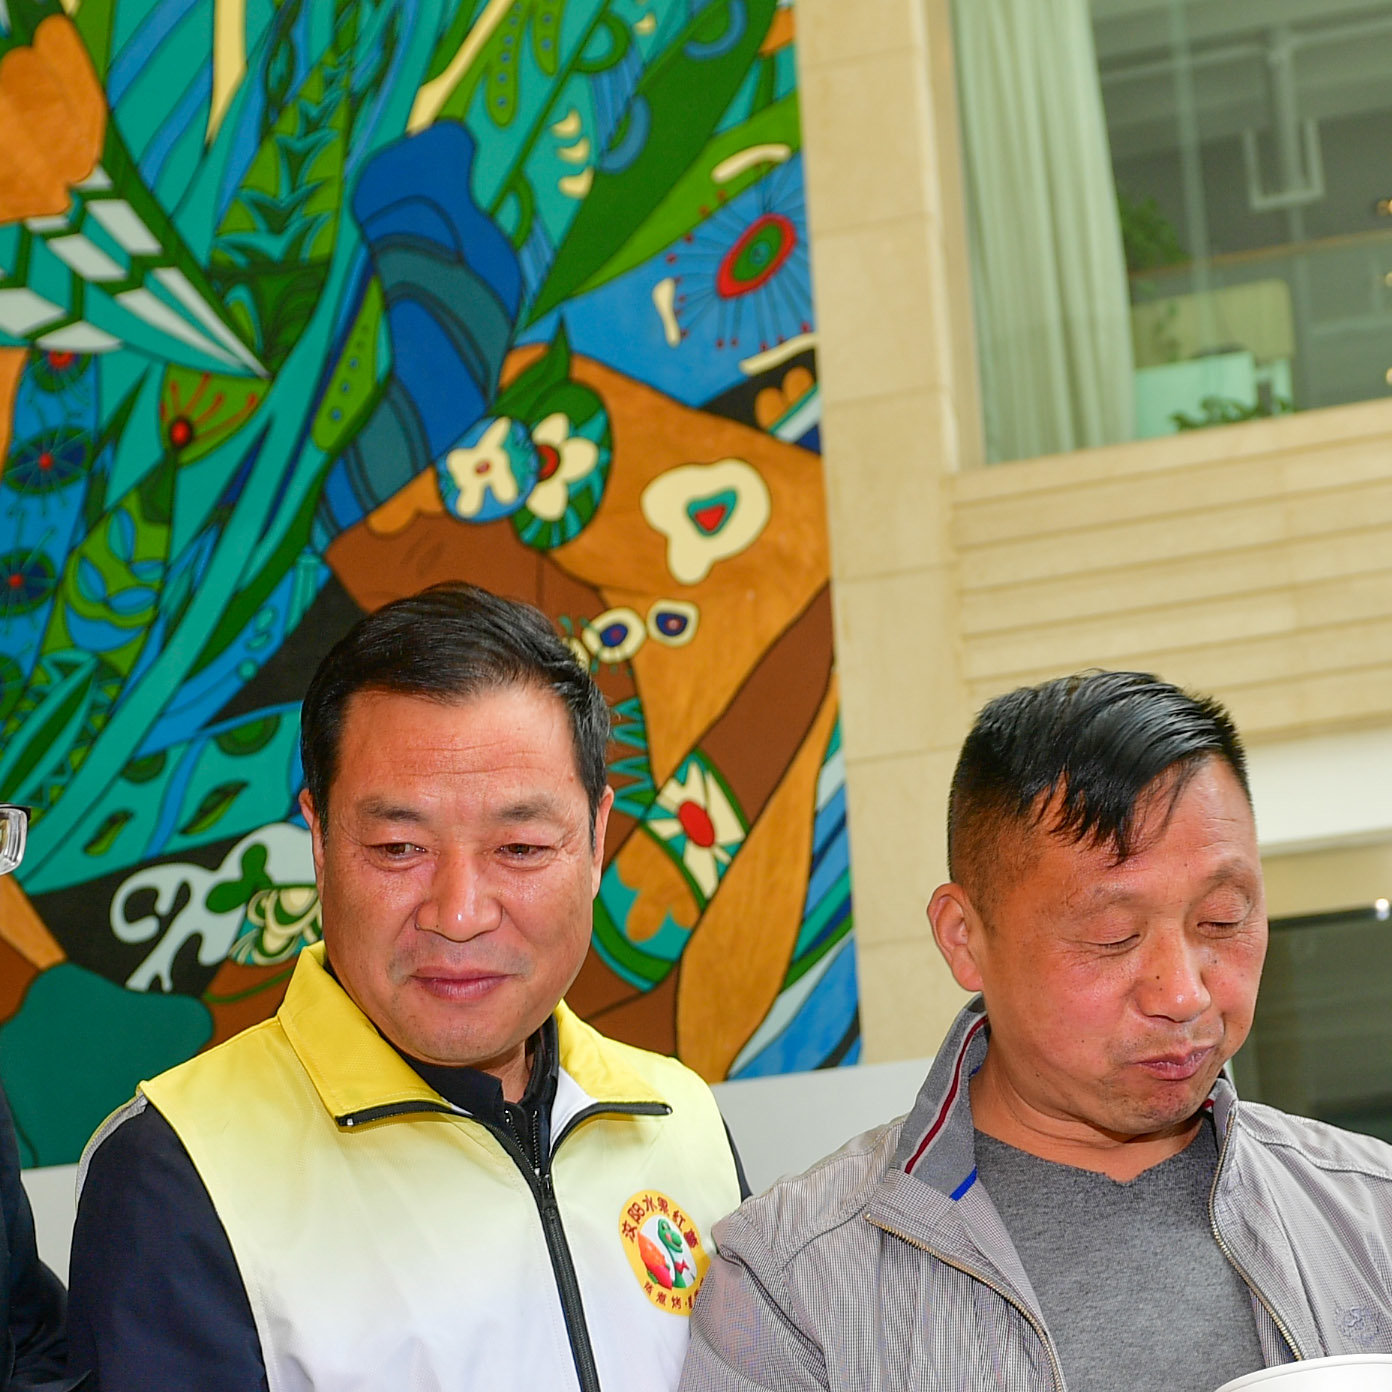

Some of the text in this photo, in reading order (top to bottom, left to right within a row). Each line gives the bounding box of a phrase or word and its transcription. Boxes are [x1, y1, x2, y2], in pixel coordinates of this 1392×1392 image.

[622, 1194, 699, 1249] 汝阳水果红薯
